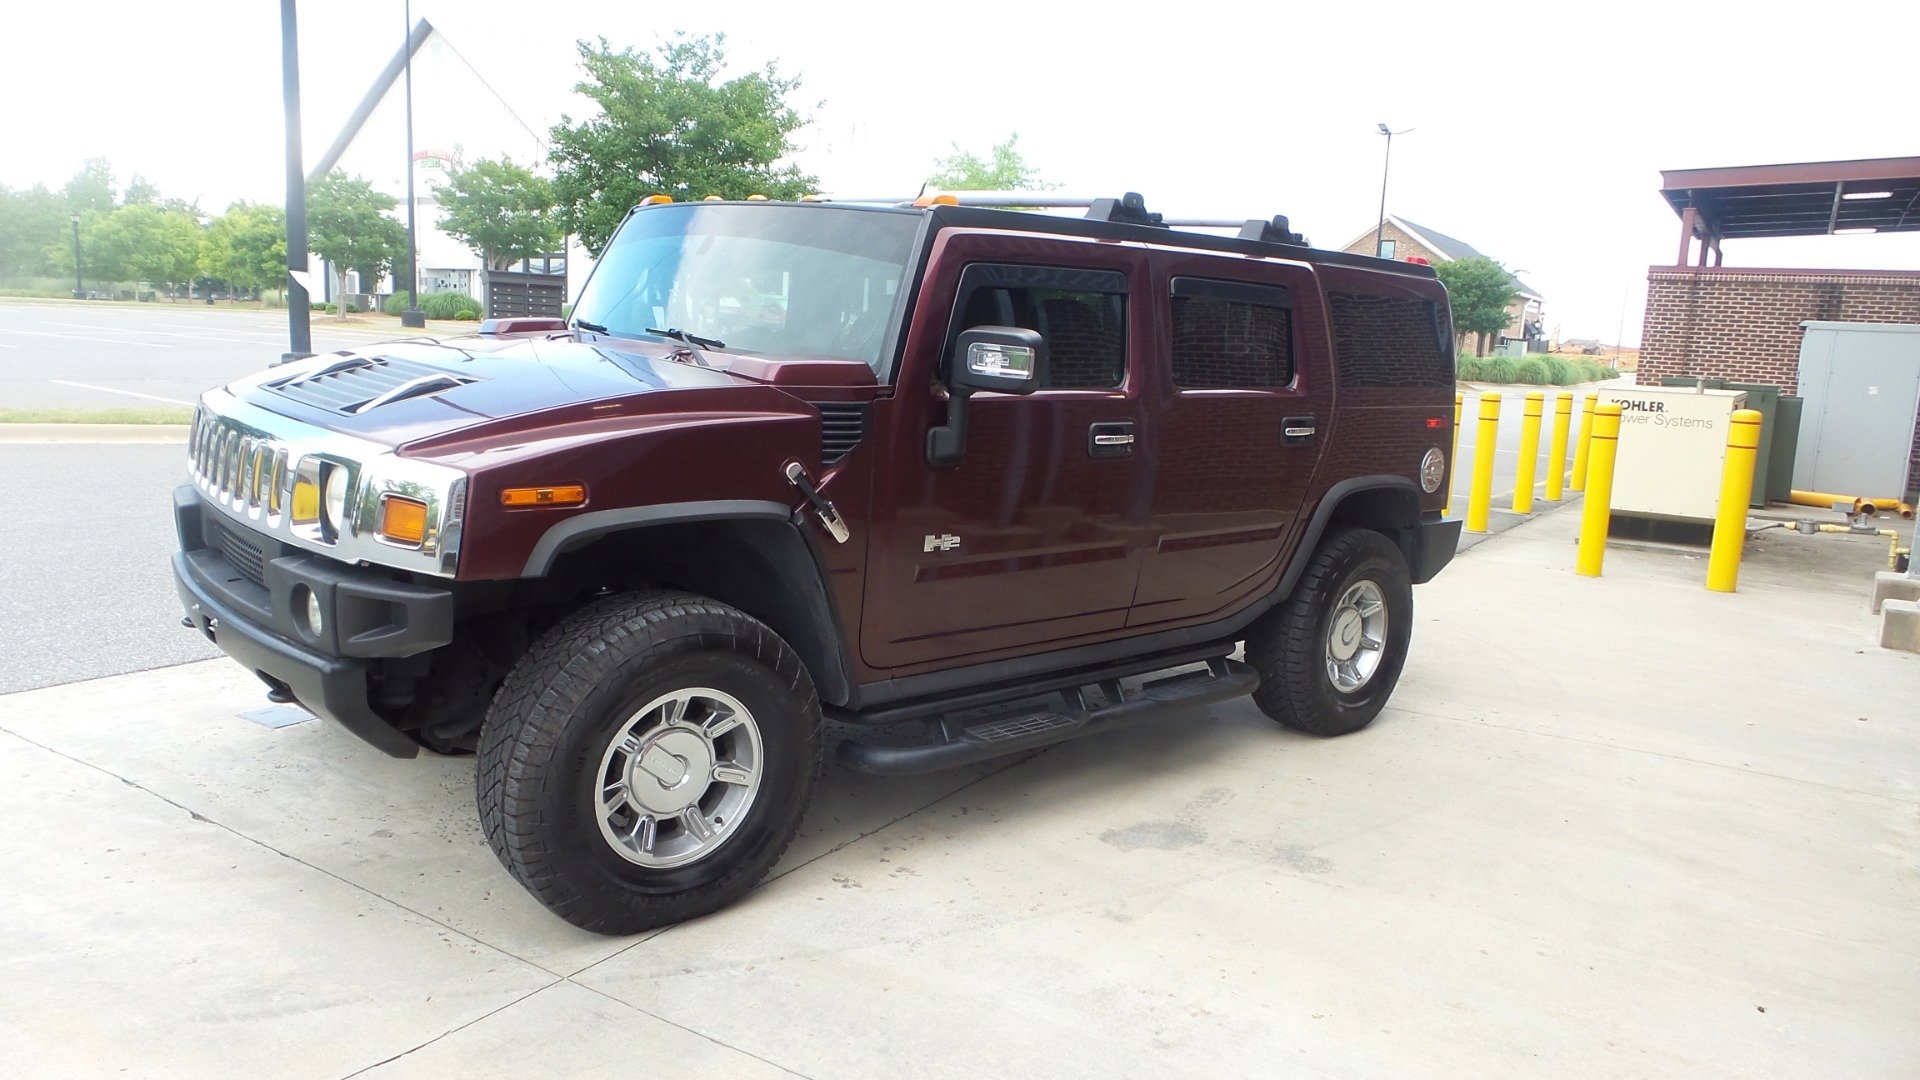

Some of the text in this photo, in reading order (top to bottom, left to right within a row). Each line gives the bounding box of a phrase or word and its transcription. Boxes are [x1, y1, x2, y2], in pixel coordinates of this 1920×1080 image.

[1620, 413, 1713, 429] ower Systems
[923, 533, 961, 553] H2
